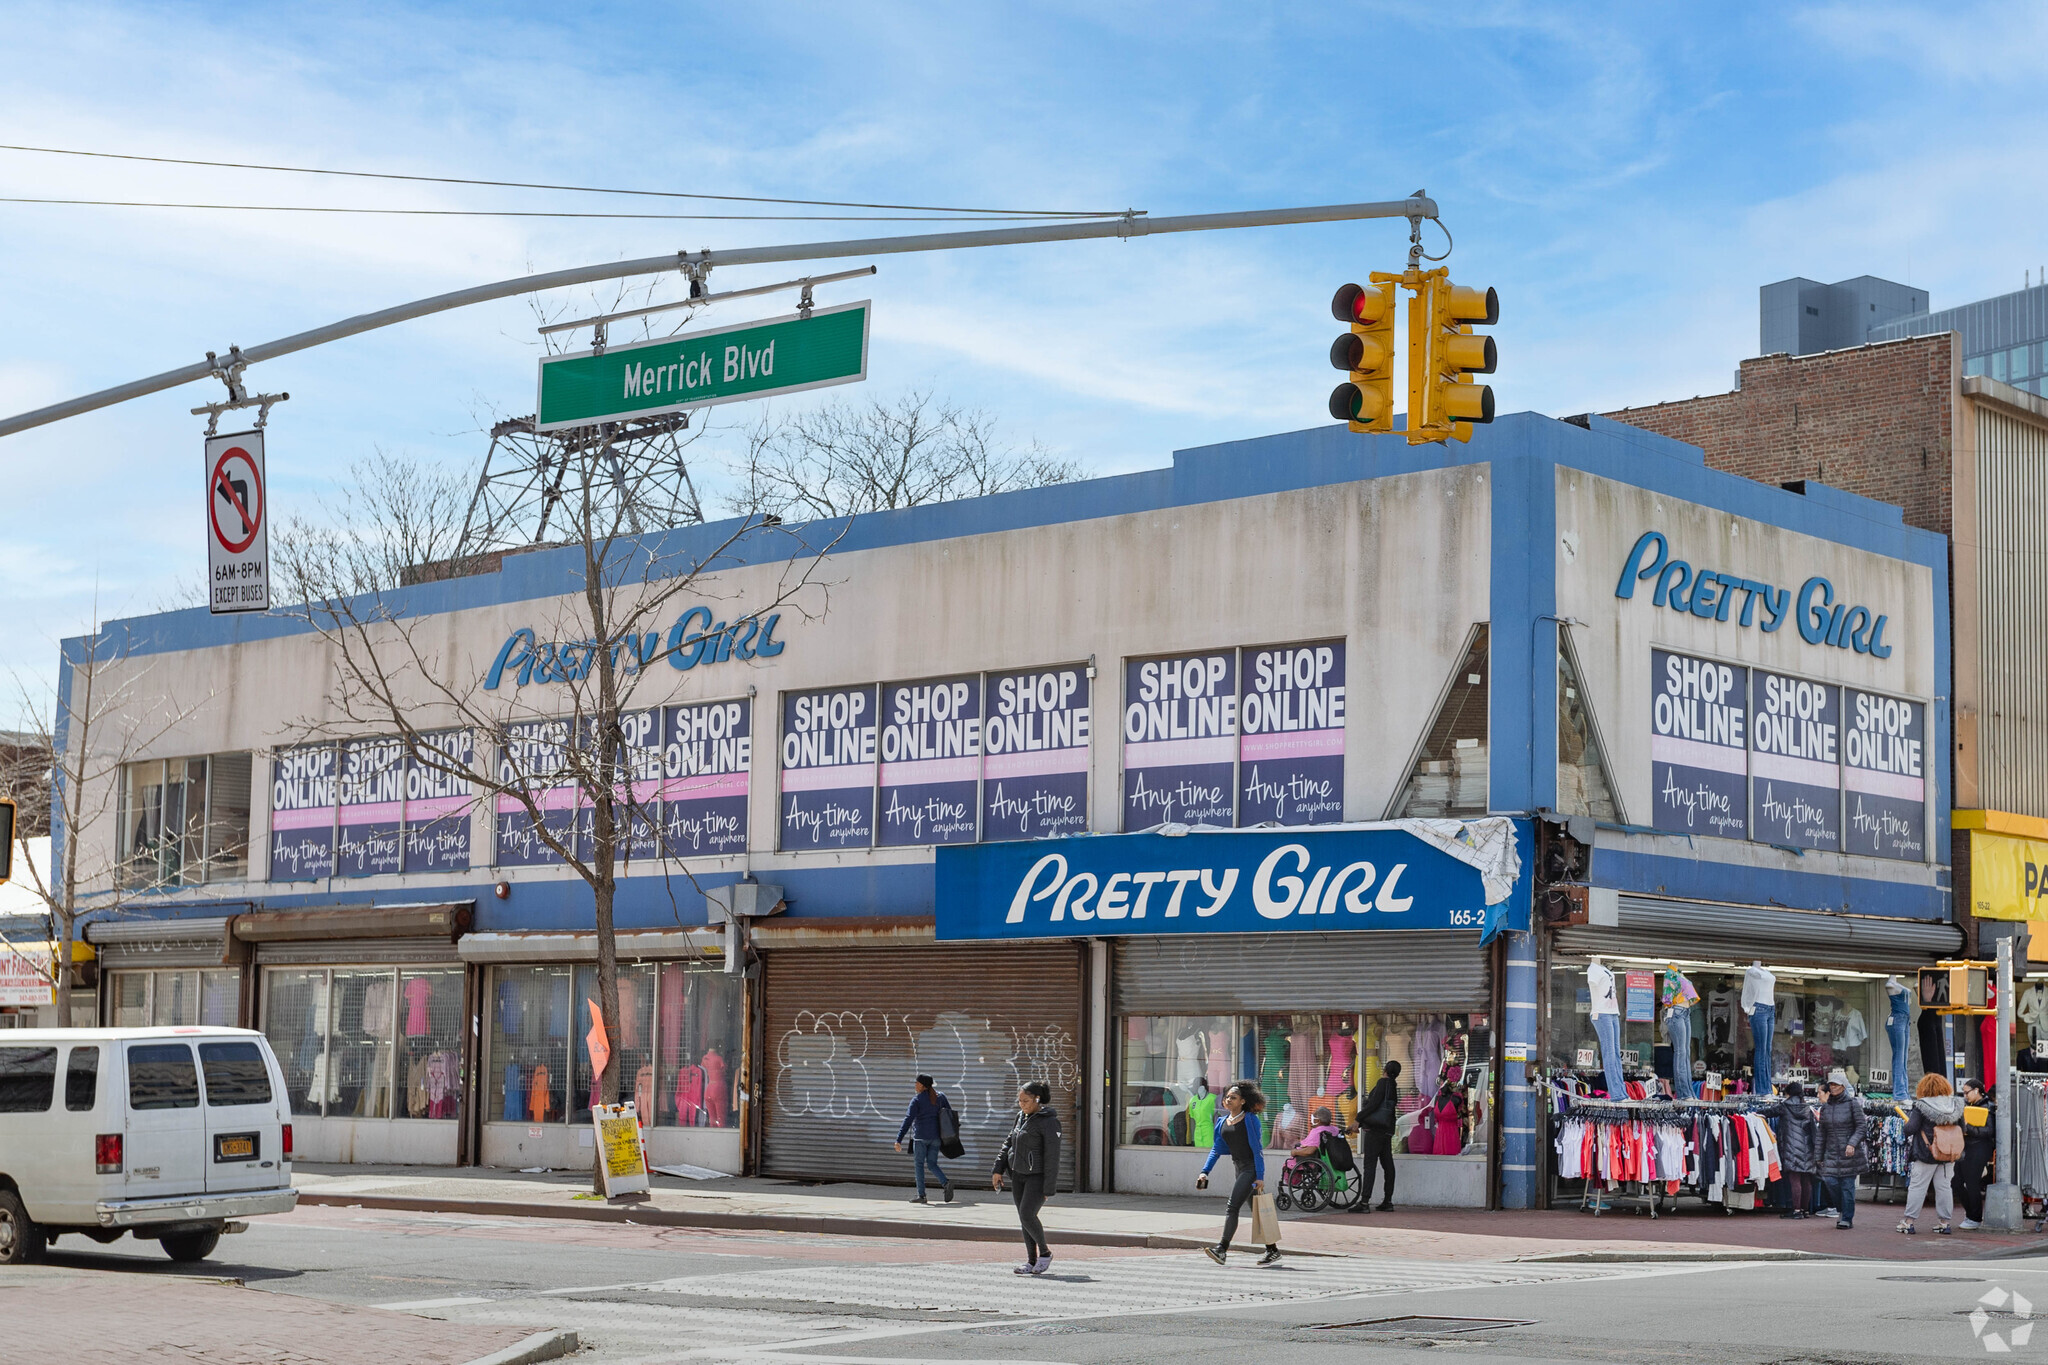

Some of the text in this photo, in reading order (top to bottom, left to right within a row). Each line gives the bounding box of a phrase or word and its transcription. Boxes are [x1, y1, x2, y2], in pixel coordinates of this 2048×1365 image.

[623, 339, 775, 399] Merrick Blvd
[215, 561, 262, 581] 6AM-8PM
[215, 584, 263, 603] EXCEPT BUSES
[1615, 531, 1892, 659] PRETTY GIRL
[1139, 656, 1227, 702] SHOP
[1254, 646, 1334, 693] SHOP
[1666, 655, 1733, 705] SHOP
[795, 691, 866, 732] SHOP
[894, 682, 969, 725] SHOP
[998, 671, 1077, 715] SHOP
[1242, 686, 1345, 734] ONLINE
[1765, 675, 1826, 722] SHOP
[675, 703, 742, 743] SHOP
[985, 707, 1089, 754] ONLINE
[1126, 694, 1235, 742] ONLINE
[1655, 693, 1743, 748] ONLINE
[1856, 693, 1912, 738] SHOP
[348, 739, 401, 774] SHOP
[415, 731, 472, 768] SHOP
[509, 721, 568, 759] SHOP
[664, 736, 750, 778] ONLINE
[783, 726, 876, 768] ONLINE
[882, 718, 979, 762] ONLINE
[1755, 712, 1836, 763] ONLINE
[1847, 728, 1921, 776] ONLINE
[281, 746, 332, 780] SHOP
[273, 775, 336, 810] ONLINE
[990, 782, 1076, 833] Any time
[1129, 771, 1224, 823] Any time
[1245, 764, 1333, 819] Any time
[1296, 799, 1341, 821] anywhere
[1662, 766, 1730, 827] Any time
[1762, 781, 1824, 839] Any time
[669, 803, 738, 850] Any time
[786, 795, 862, 843] Any time
[885, 789, 966, 839] Any time
[932, 821, 975, 841] anywhere
[1040, 813, 1085, 833] anywhere
[1184, 802, 1233, 824] anywhere
[1709, 814, 1744, 835] anywhere
[1853, 795, 1910, 850] Any time
[273, 833, 327, 873] Any time
[339, 828, 395, 870] Any time
[407, 823, 467, 866] Any time
[709, 834, 746, 851] anywhere
[829, 825, 869, 845] anywhere
[1805, 827, 1837, 846] anywhere
[1892, 838, 1921, 856] anywhere
[1005, 844, 1414, 924] PRETTY GIRL
[1449, 909, 1485, 925] 165-2
[0, 959, 11, 975] NT
[1626, 1051, 1638, 1063] $10
[2037, 1042, 2044, 1054] 3
[1788, 1069, 1808, 1080] 399
[1871, 1071, 1887, 1081] 1.00
